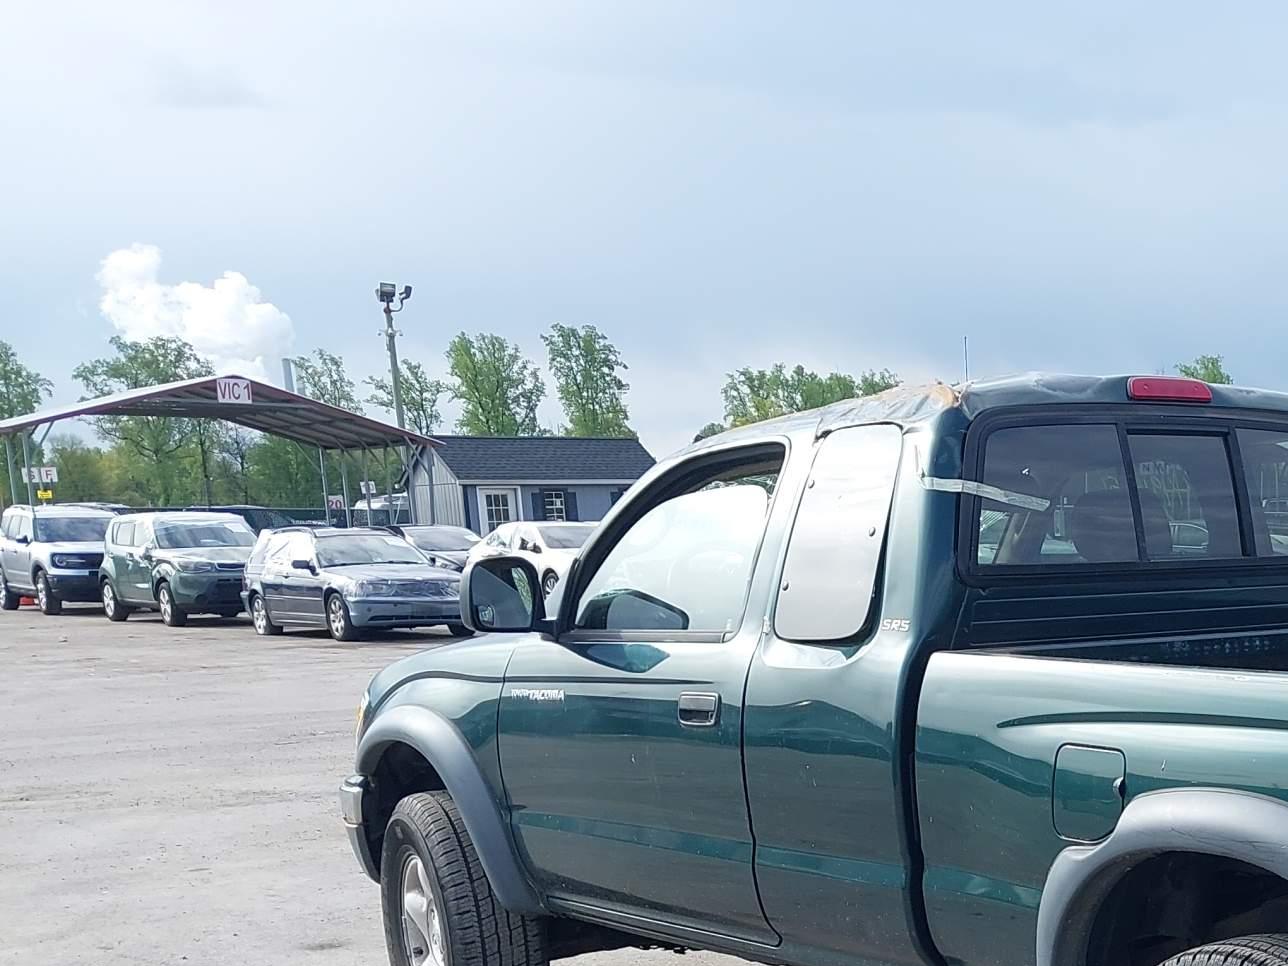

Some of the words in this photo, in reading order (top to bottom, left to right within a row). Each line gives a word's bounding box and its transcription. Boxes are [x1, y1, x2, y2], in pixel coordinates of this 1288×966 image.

[218, 381, 241, 400] VIC
[243, 382, 251, 401] 1
[45, 469, 53, 480] F
[881, 618, 911, 631] SR5
